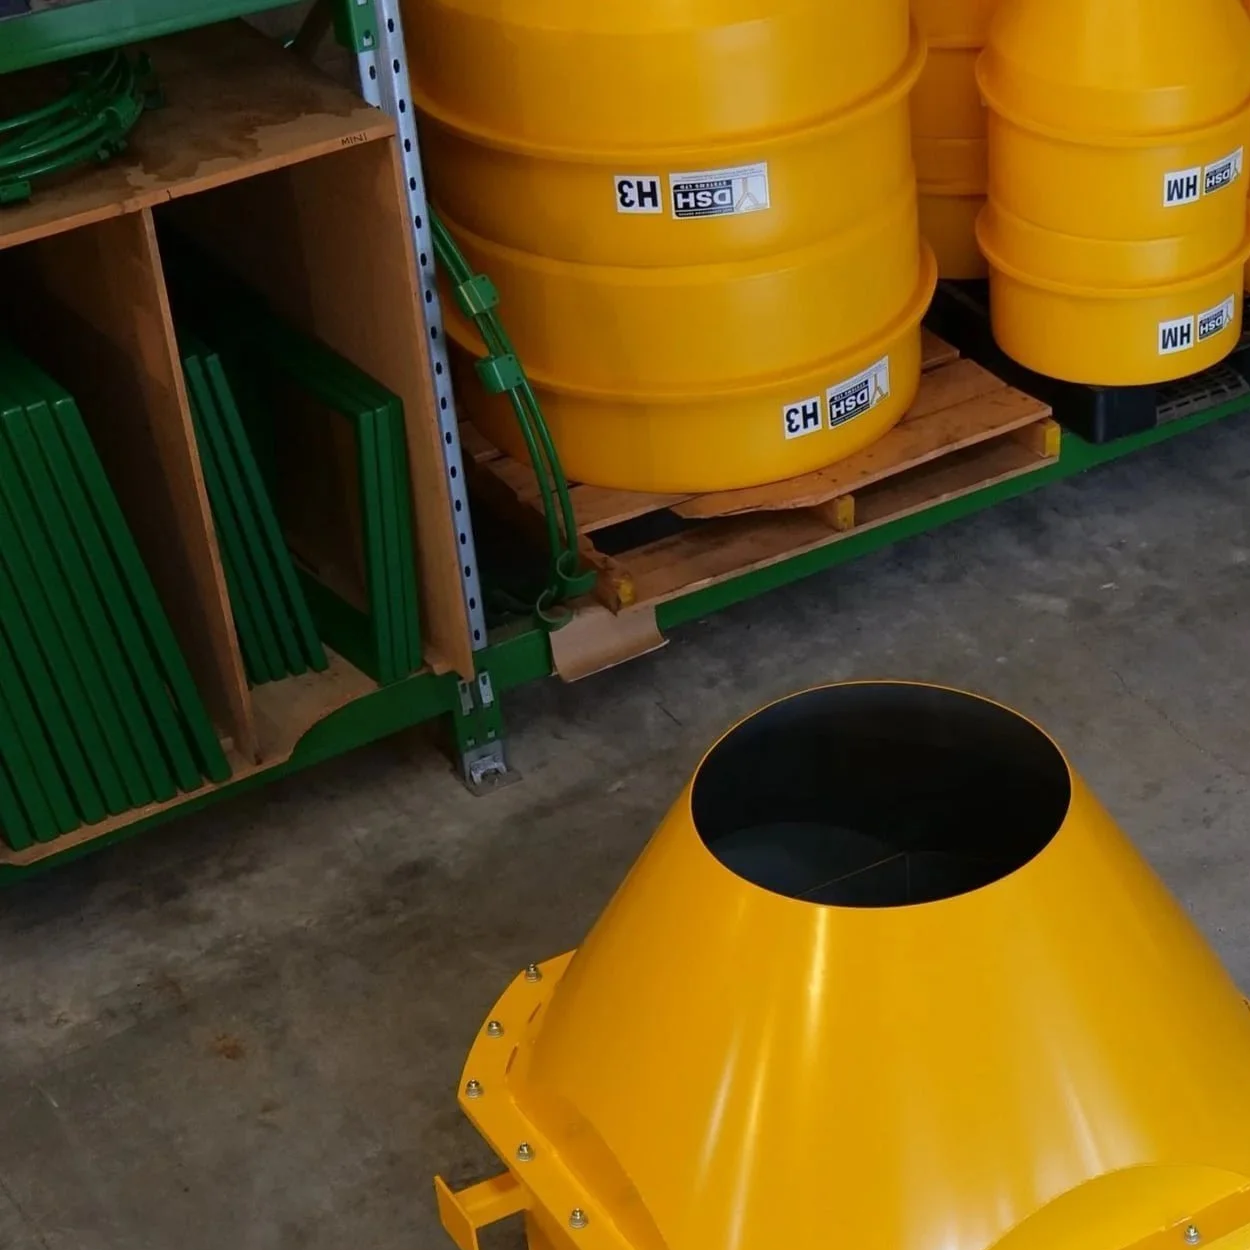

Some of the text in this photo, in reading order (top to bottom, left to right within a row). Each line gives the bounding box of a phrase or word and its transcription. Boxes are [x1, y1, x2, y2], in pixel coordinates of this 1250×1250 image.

[341, 131, 368, 146] MINI
[1167, 174, 1197, 202] HM
[1206, 169, 1230, 187] DSH
[617, 180, 658, 208] H3
[675, 188, 732, 209] DSH
[1162, 323, 1191, 350] HM
[1200, 315, 1223, 335] DSH
[785, 401, 819, 433] H3
[831, 388, 868, 419] DSH
